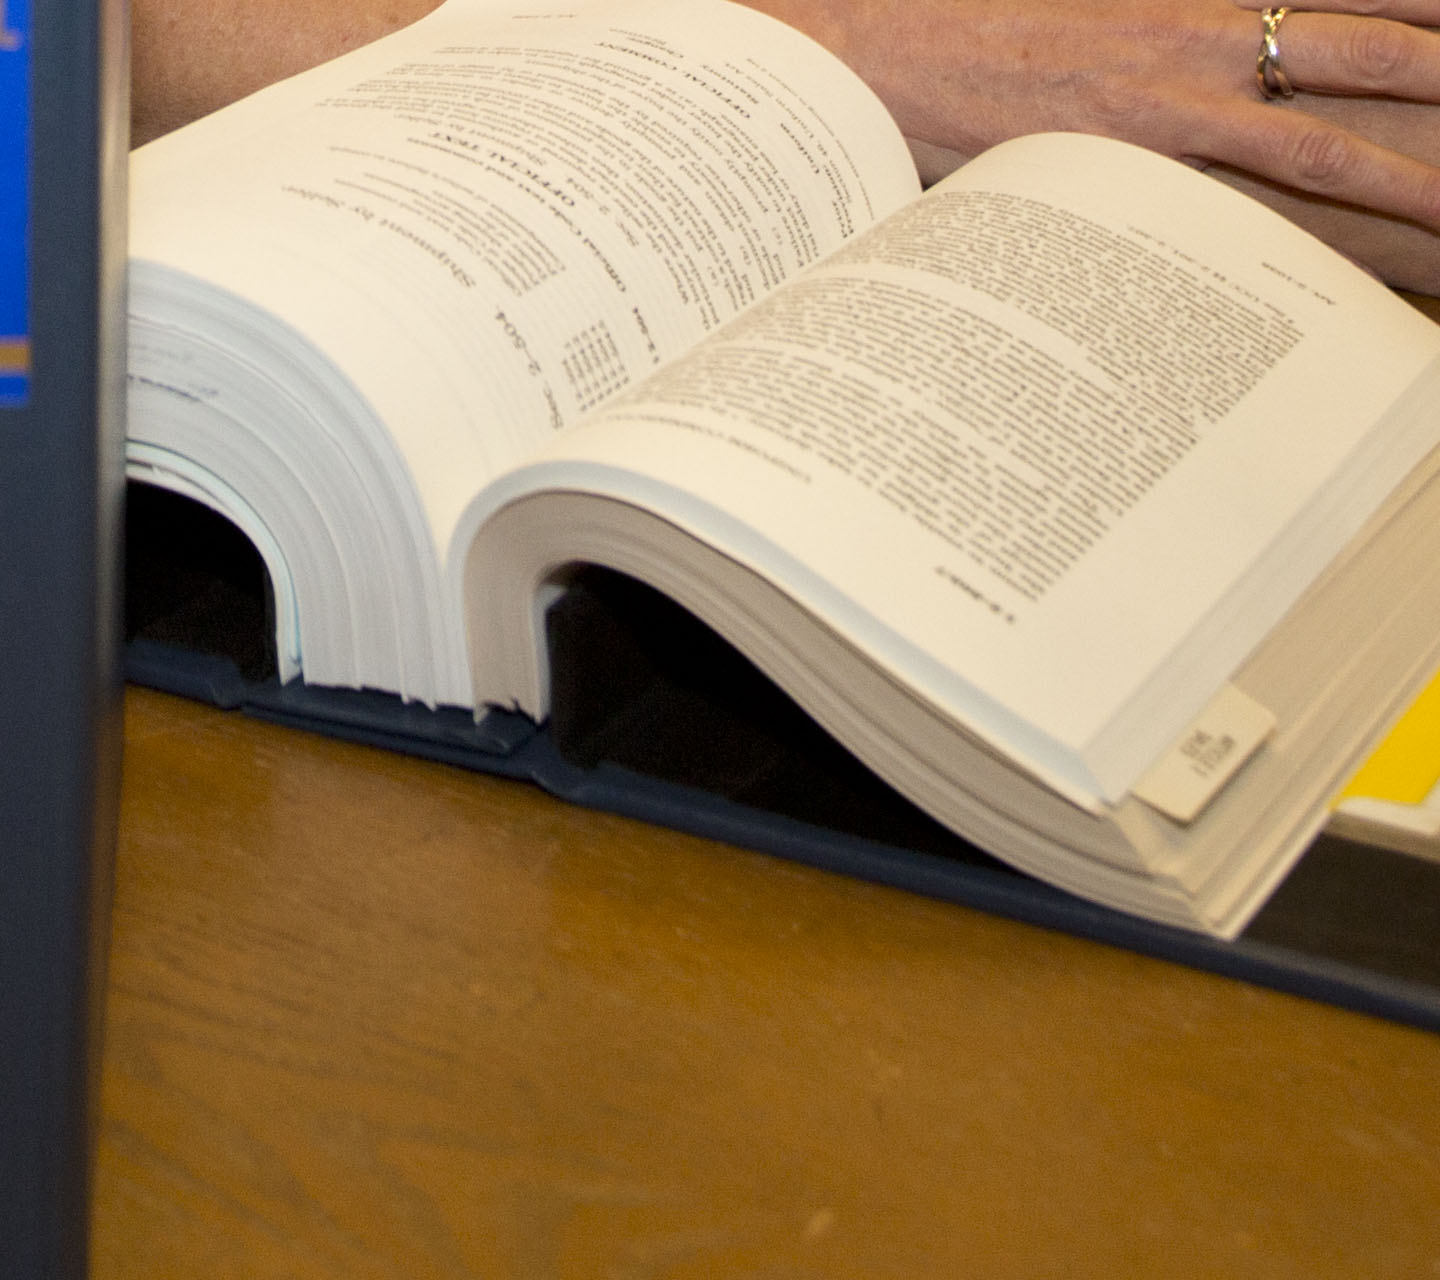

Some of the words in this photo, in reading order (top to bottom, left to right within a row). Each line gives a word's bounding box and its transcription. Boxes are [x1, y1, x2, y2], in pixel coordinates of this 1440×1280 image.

[679, 69, 753, 120] OFFICIAL
[427, 130, 483, 152] TEXT
[483, 150, 579, 208] OFFICIAL
[376, 217, 478, 291] Shipment
